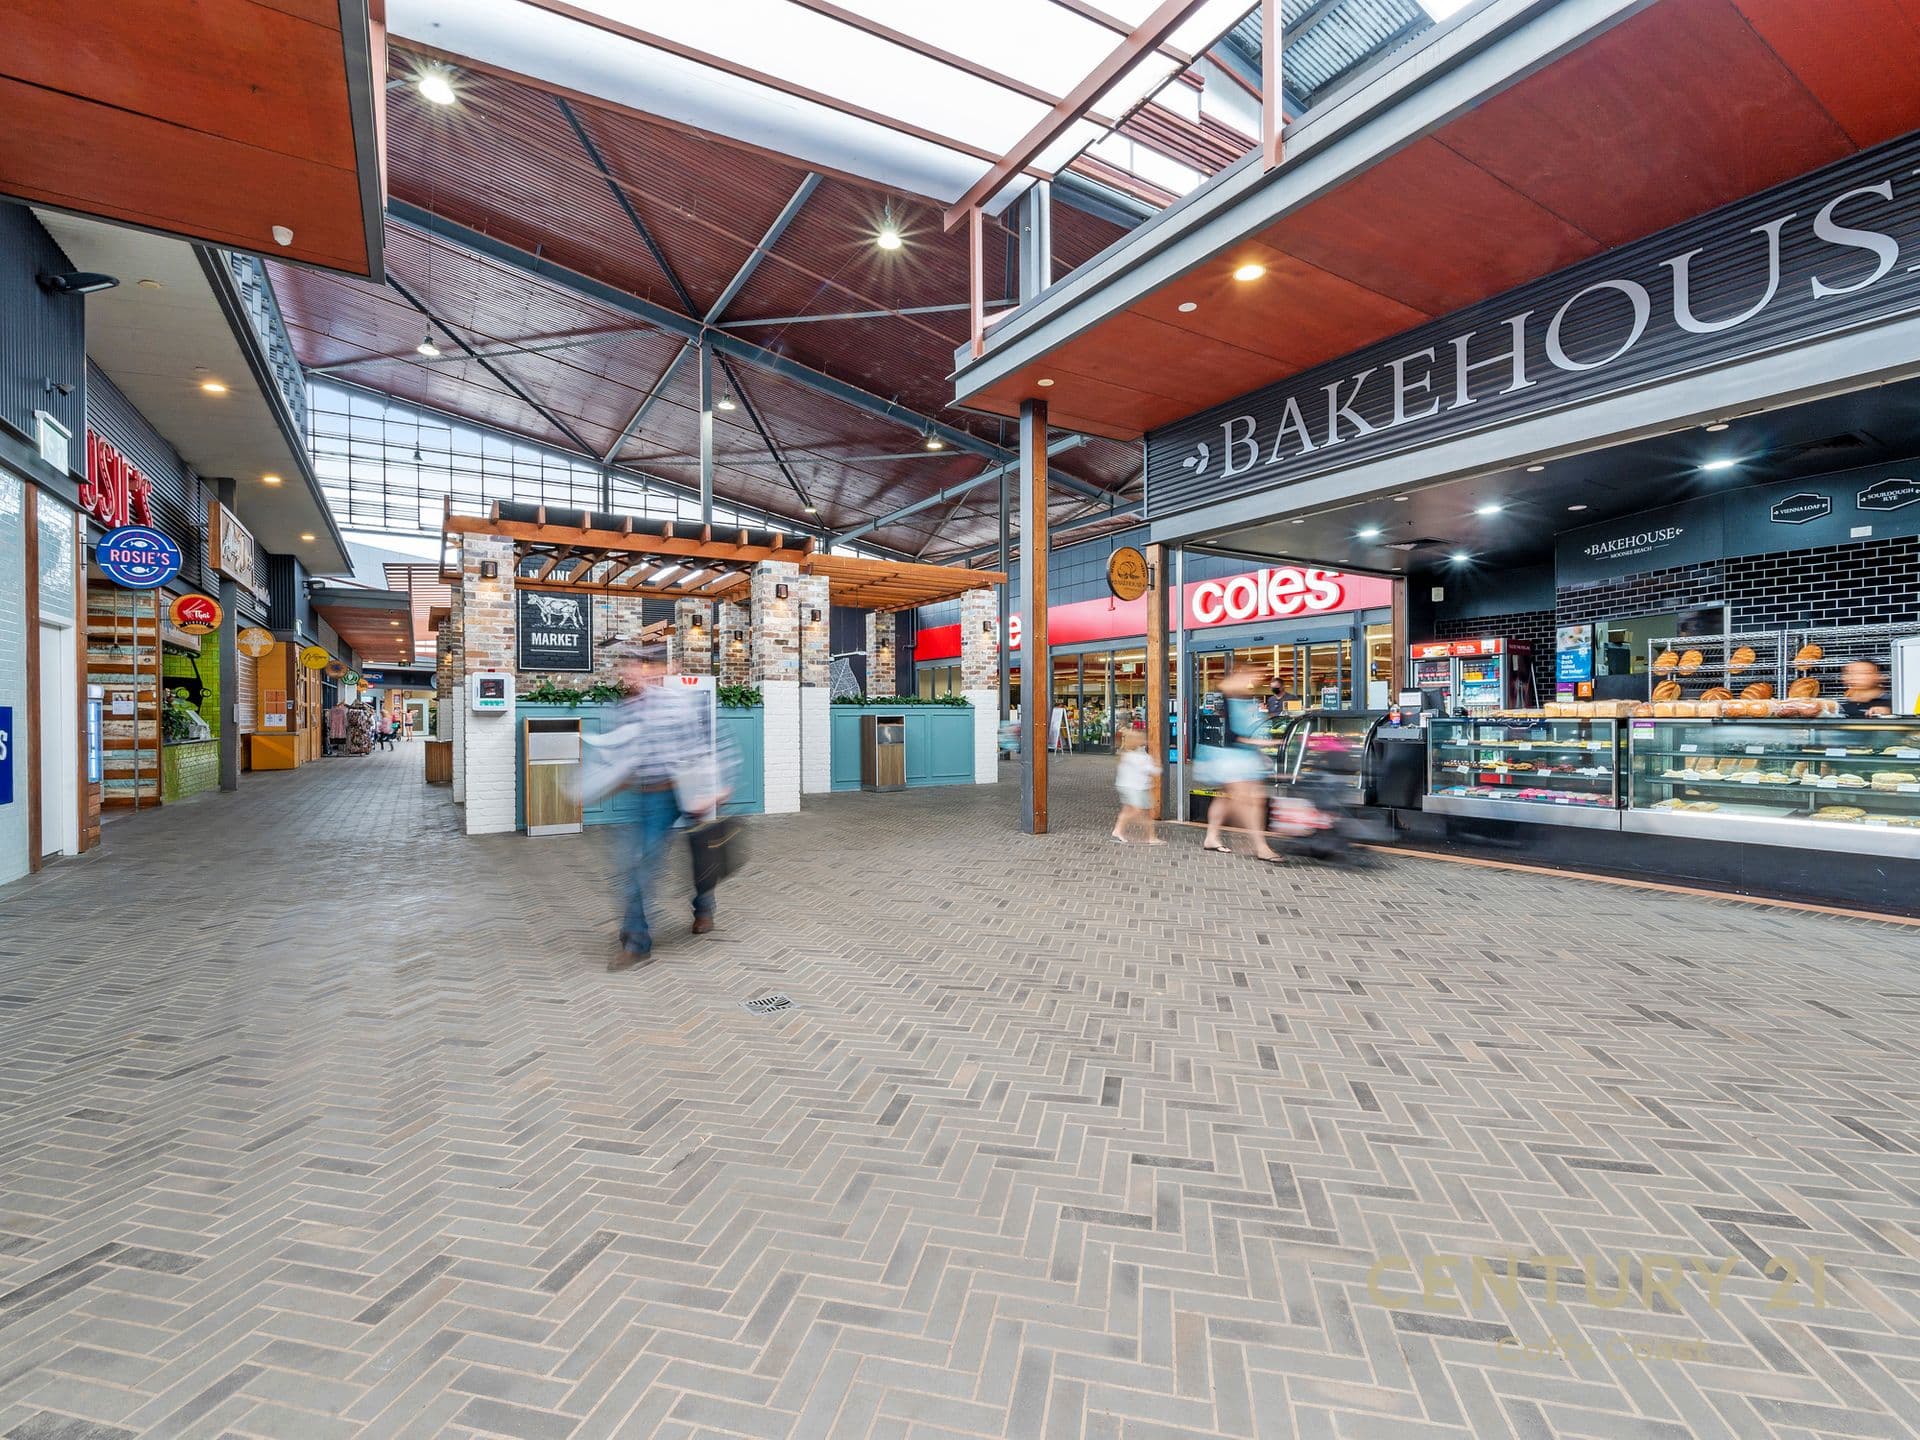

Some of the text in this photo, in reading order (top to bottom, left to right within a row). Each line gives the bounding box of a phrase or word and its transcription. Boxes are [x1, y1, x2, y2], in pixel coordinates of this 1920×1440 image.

[1220, 169, 1920, 479] BAKEHOUS
[1867, 487, 1914, 499] SOURDOUGH
[1780, 503, 1821, 515] VIENNA LOAF
[1591, 527, 1676, 555] BAKEHOUSE
[110, 549, 170, 565] ROSIE'S
[1634, 546, 1652, 554] BEACH
[1192, 568, 1341, 623] coles
[531, 632, 579, 647] MARKET
